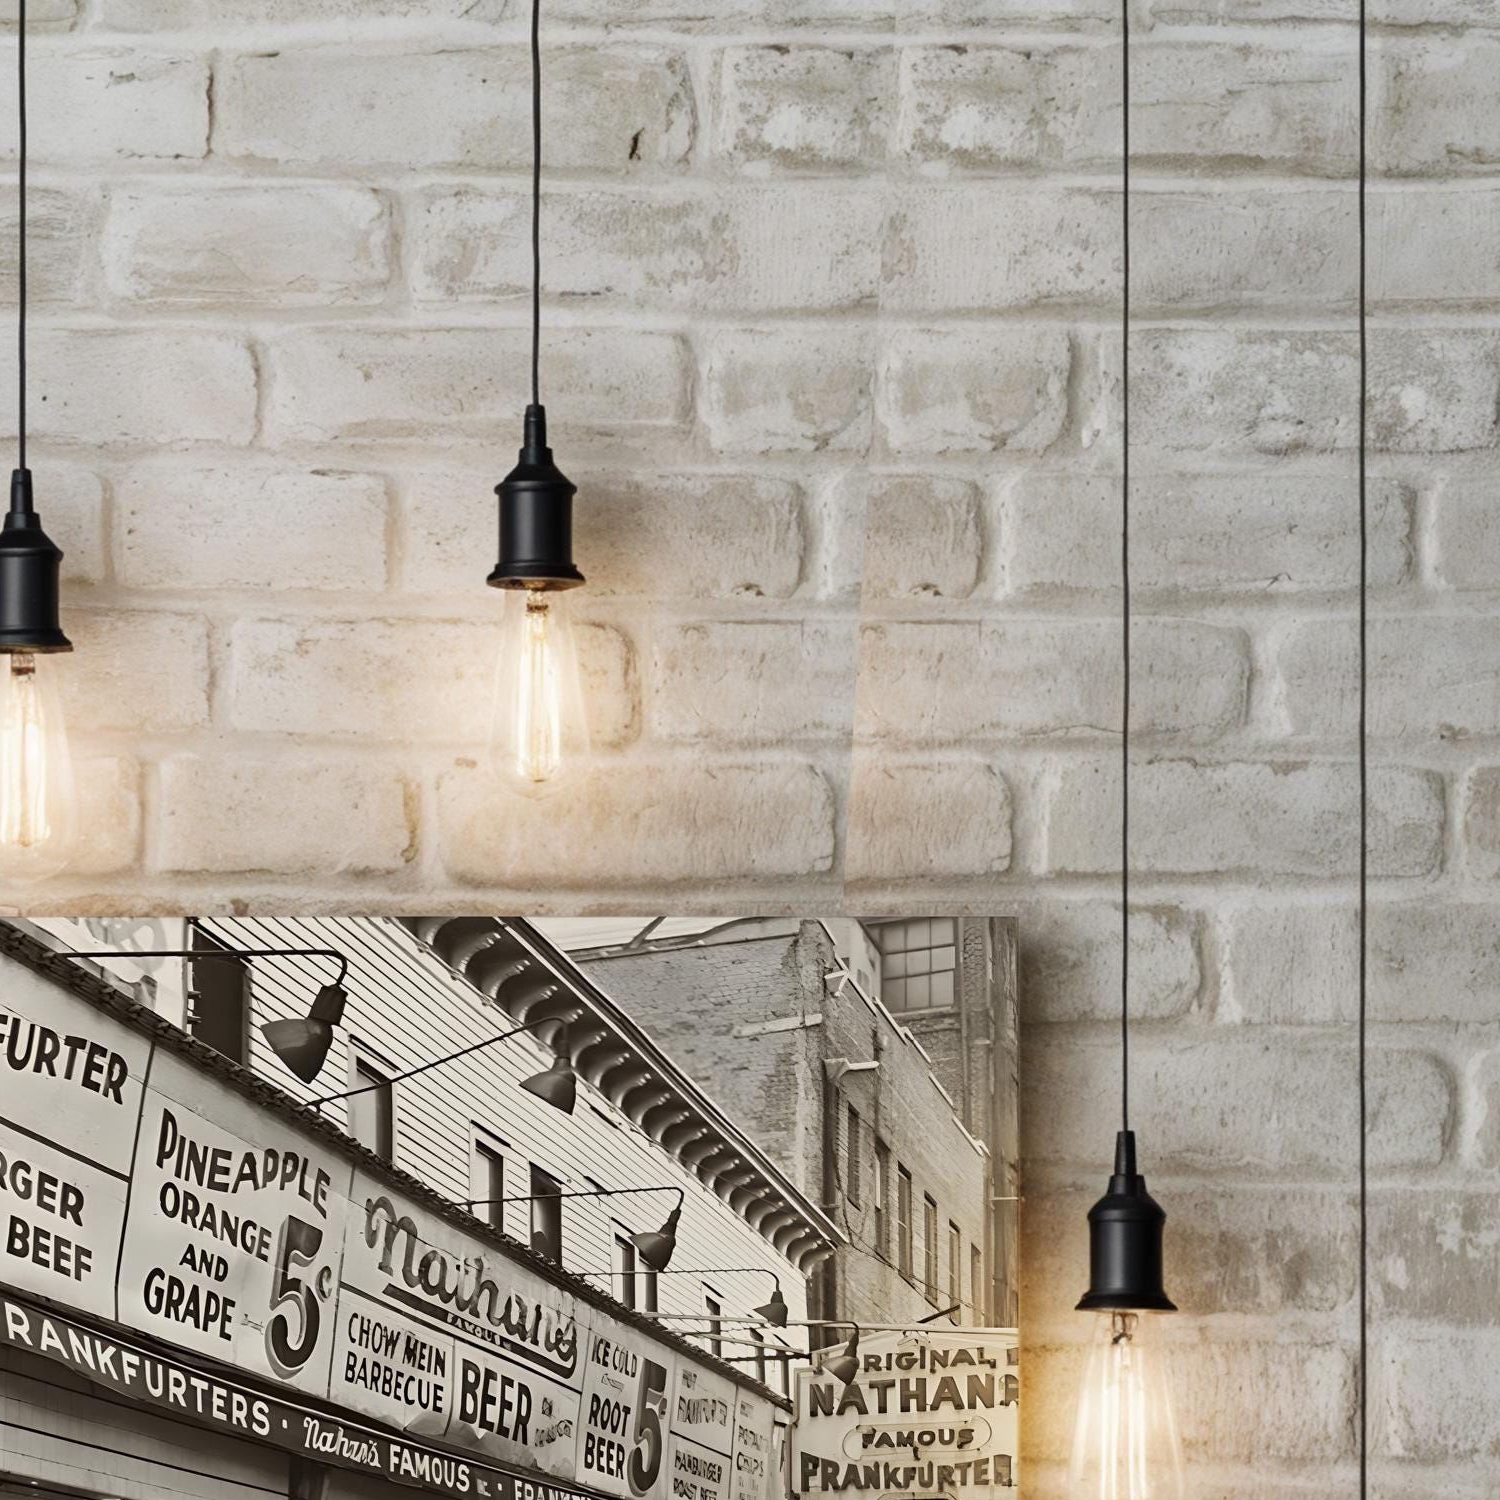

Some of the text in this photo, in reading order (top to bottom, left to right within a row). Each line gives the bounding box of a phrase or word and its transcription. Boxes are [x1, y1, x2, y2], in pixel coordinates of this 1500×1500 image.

[156, 1107, 331, 1220] PINEAPPLE
[6, 1214, 93, 1282] BEEF
[160, 1181, 272, 1263] ORANGE
[179, 1243, 229, 1282] AND
[143, 1267, 236, 1341] GRAPE
[348, 1312, 447, 1378] CHOW MEIN
[592, 1335, 611, 1368] ICE
[863, 1345, 996, 1374] RIGINAL
[345, 1350, 444, 1413] BARBECUE
[459, 1358, 532, 1446] BEER
[588, 1393, 631, 1437] ROOT
[861, 1429, 975, 1450] FAMOUS
[389, 1443, 470, 1492] FAMOUS
[584, 1431, 626, 1480] BEER
